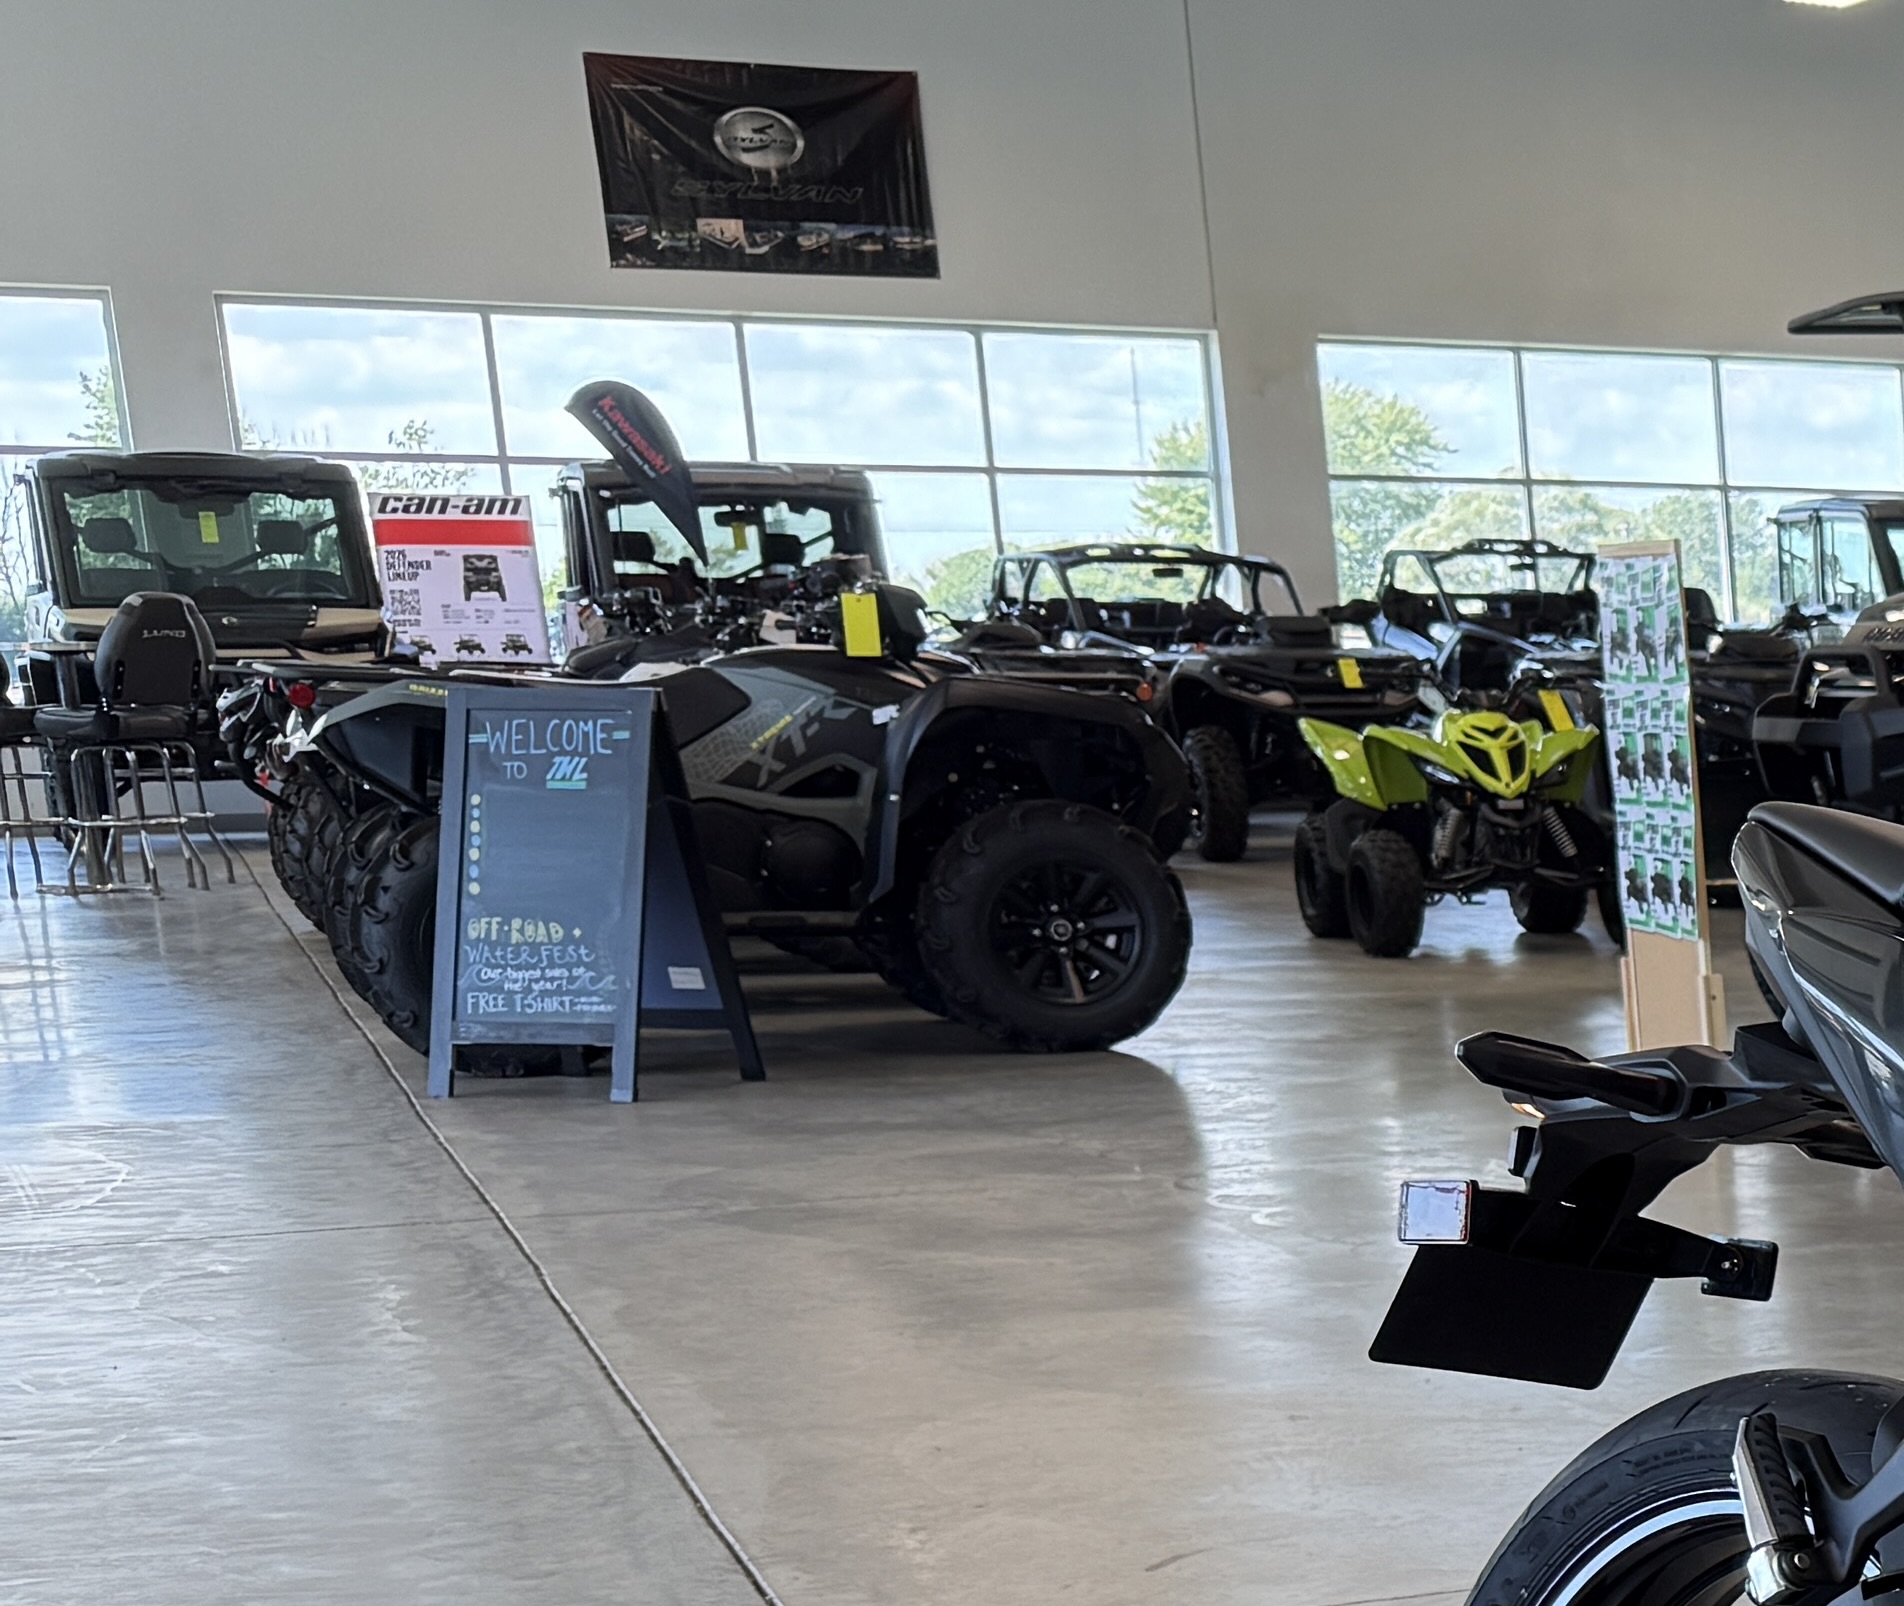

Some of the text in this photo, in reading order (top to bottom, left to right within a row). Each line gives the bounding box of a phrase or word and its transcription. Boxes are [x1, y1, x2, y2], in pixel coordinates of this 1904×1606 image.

[377, 495, 522, 516] can-am
[485, 718, 615, 755] WELCOME
[501, 761, 528, 780] TO
[467, 992, 507, 1014] FREE
